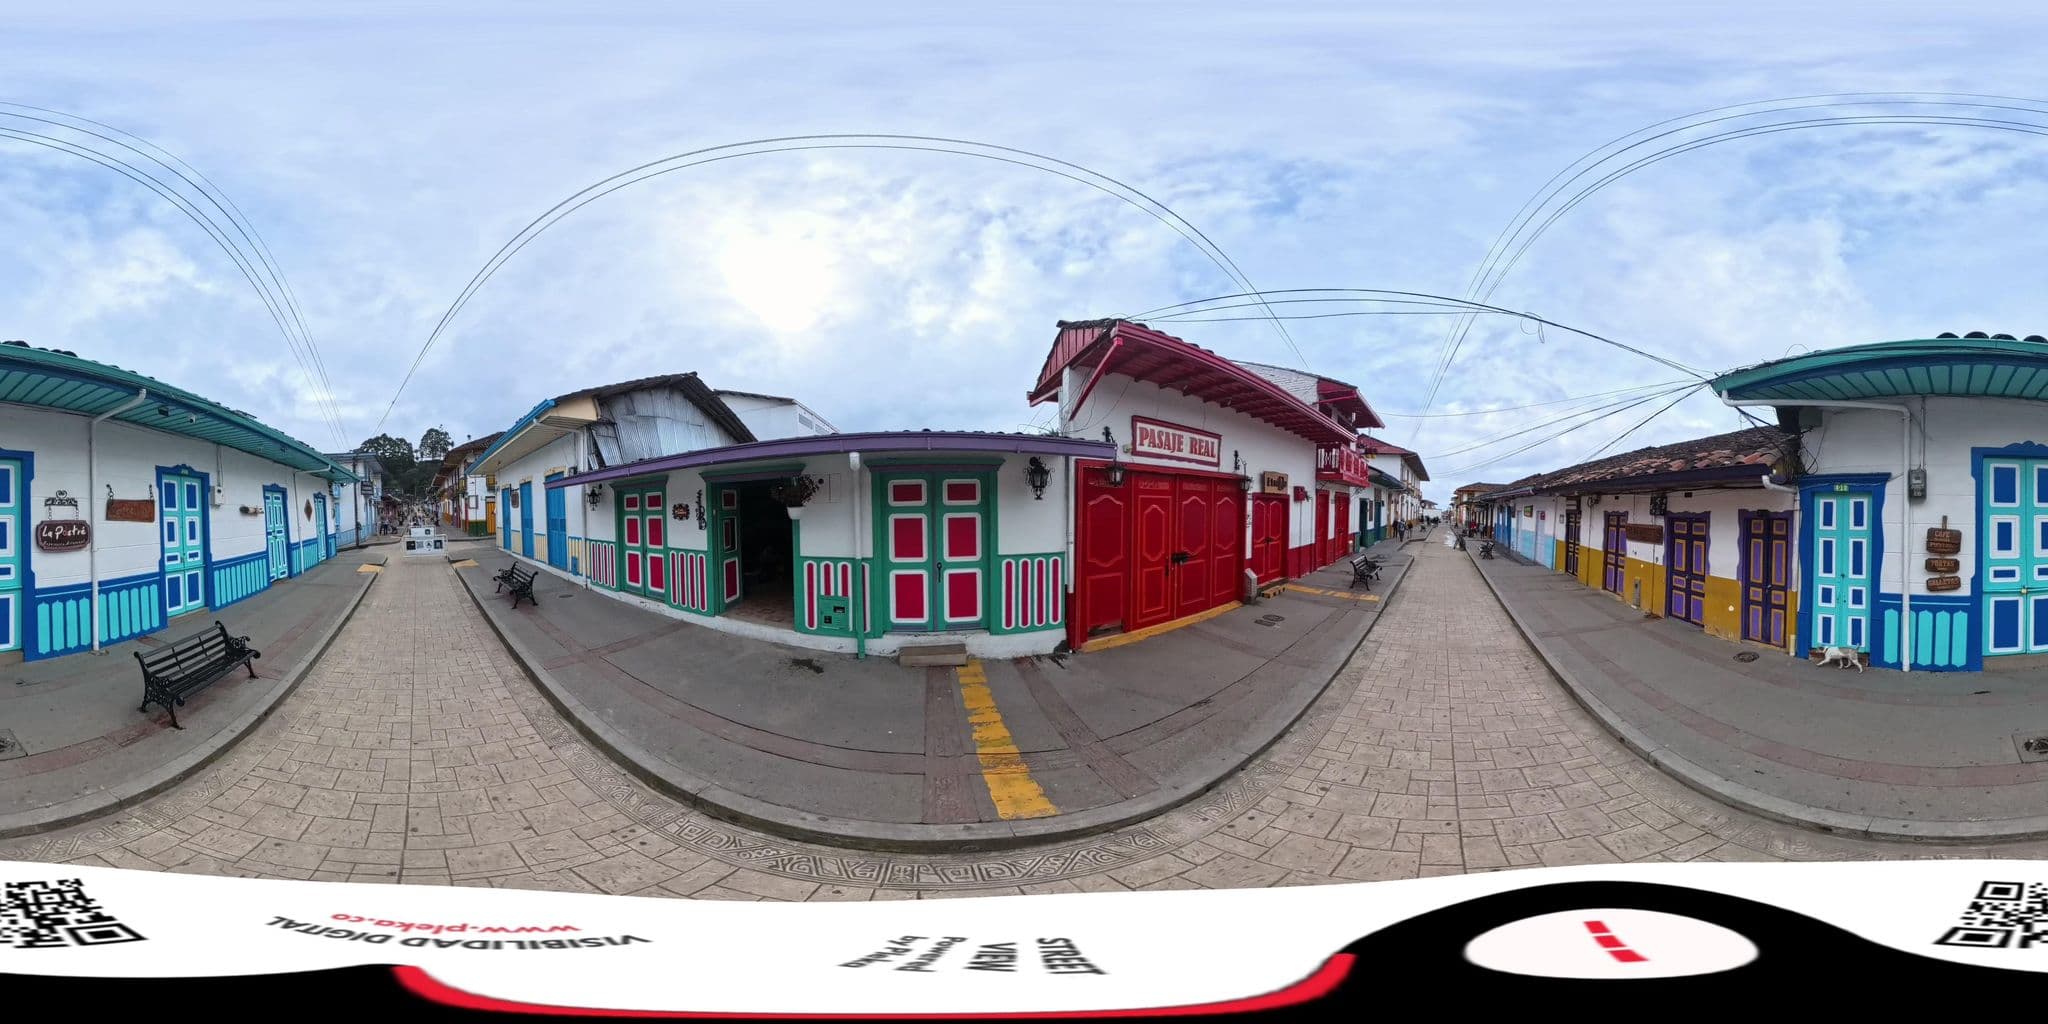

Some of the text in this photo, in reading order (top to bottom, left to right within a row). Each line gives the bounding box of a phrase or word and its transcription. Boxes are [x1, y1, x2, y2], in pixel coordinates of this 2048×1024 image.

[1138, 426, 1217, 458] PASAJE REAL
[42, 525, 53, 538] La
